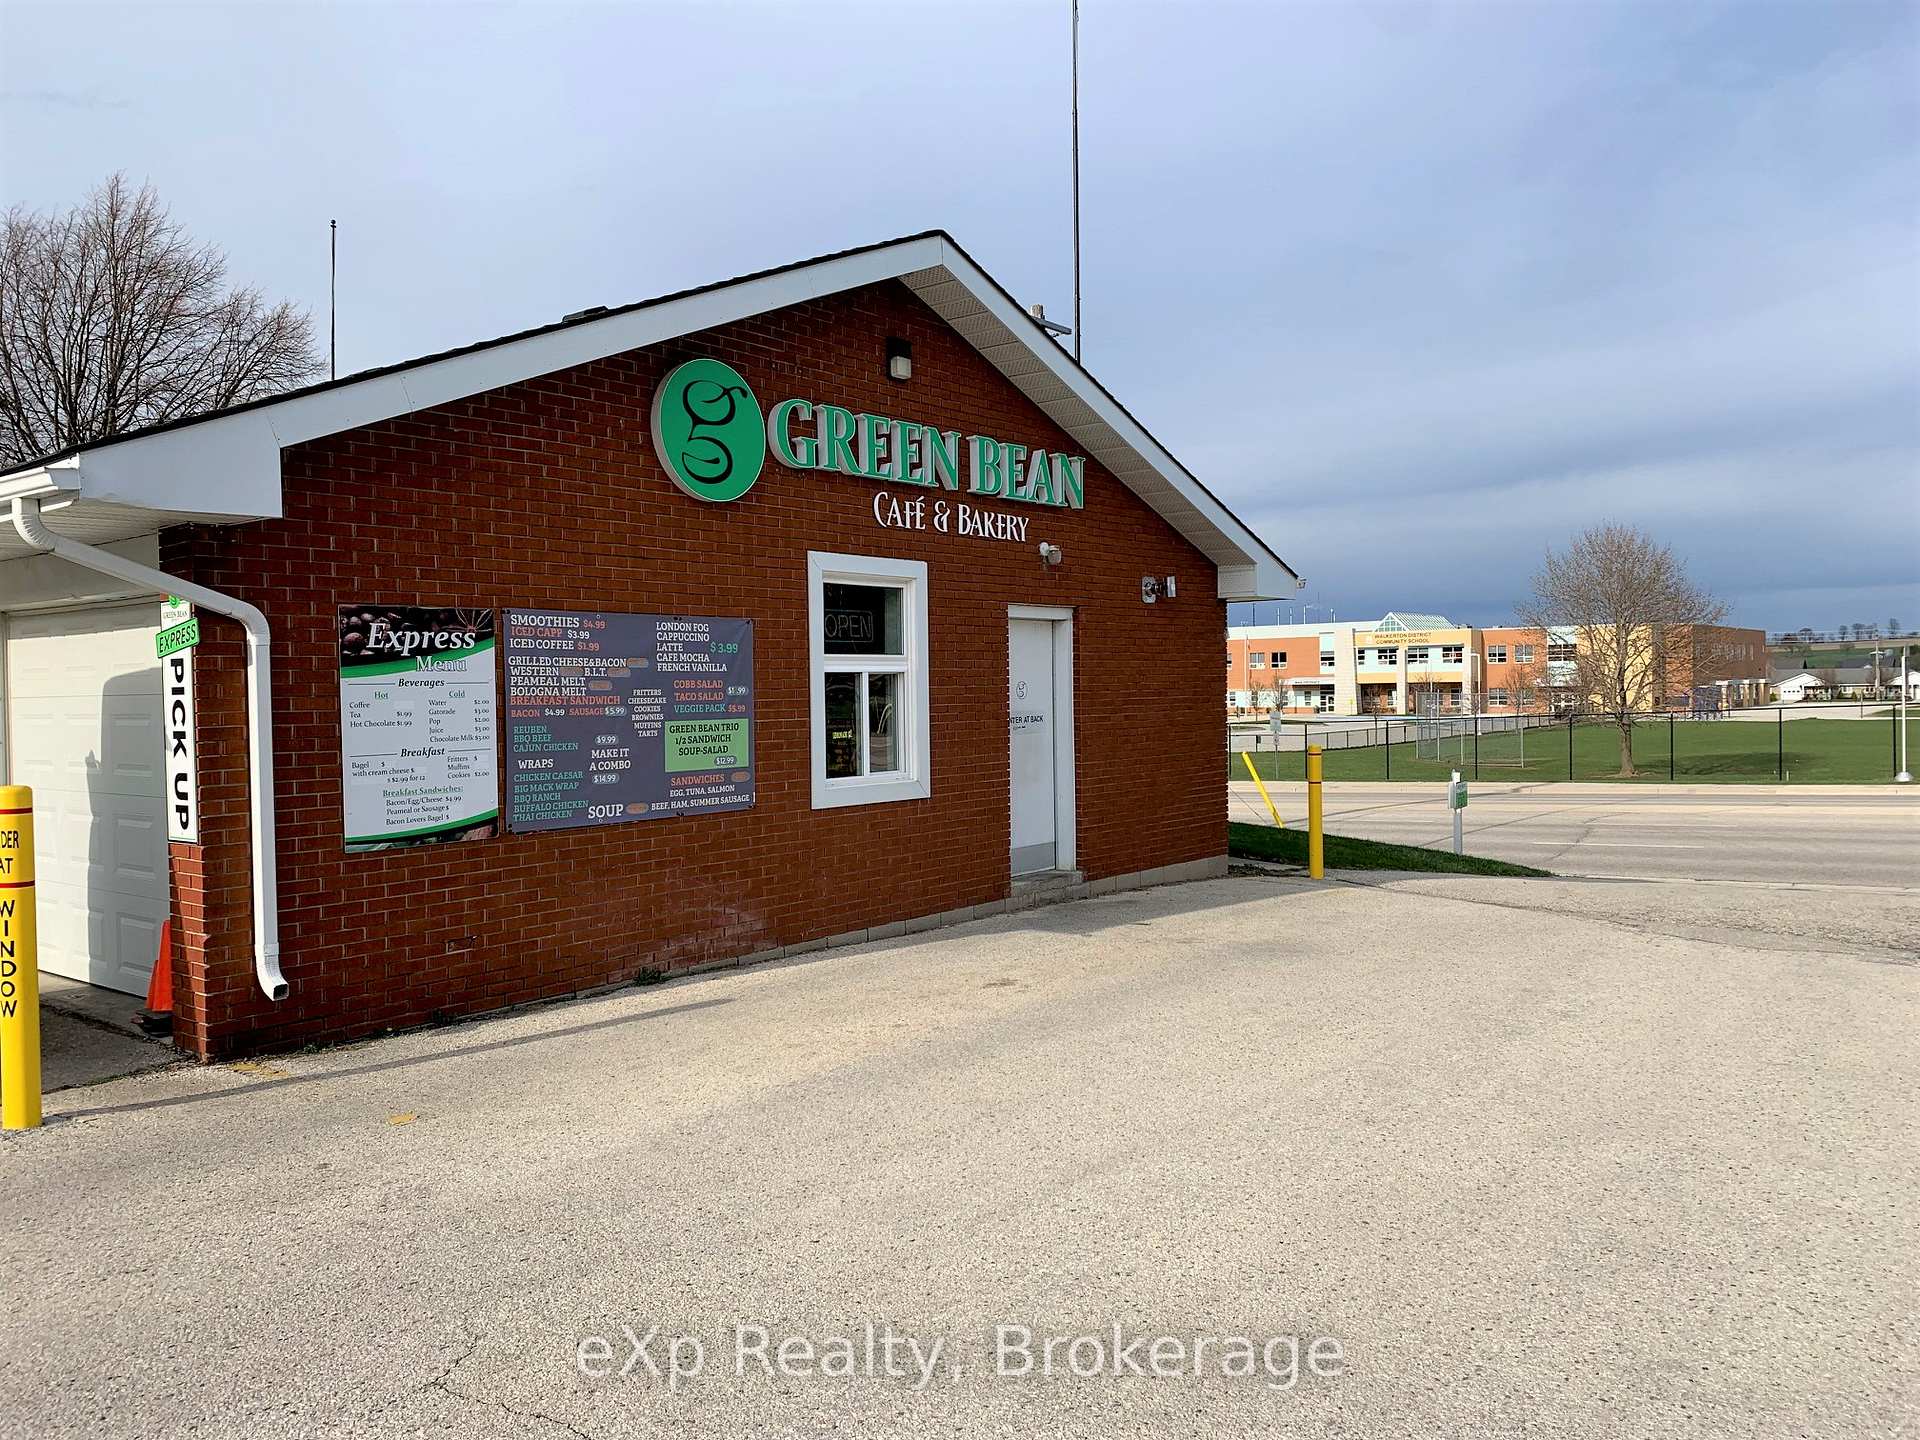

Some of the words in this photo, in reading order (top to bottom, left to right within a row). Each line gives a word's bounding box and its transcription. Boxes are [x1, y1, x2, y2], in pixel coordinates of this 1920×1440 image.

[768, 397, 961, 491] GREEN
[967, 434, 1086, 510] BEAN
[932, 499, 949, 533] &
[958, 504, 1029, 543] BAKERY
[510, 614, 580, 628] SMOOTHIES
[583, 620, 606, 629] $4.99
[825, 613, 872, 639] OPEN
[511, 626, 535, 636] ICED
[537, 627, 562, 637] CAPP
[567, 630, 590, 639] $3.99
[656, 622, 691, 632] LONDON
[693, 623, 709, 633] FOG
[160, 623, 196, 654] EXPRESS
[366, 622, 476, 656] Express
[656, 632, 710, 642] CAPPUCCINO
[510, 638, 535, 648] ICED
[536, 640, 574, 649] COFFEE
[577, 642, 600, 651] $1.99
[656, 643, 684, 651] LATTE
[508, 655, 551, 666] GRILLED
[656, 653, 678, 661] CAFE
[679, 653, 711, 661] MOCHA
[415, 655, 468, 672] Menu
[657, 663, 690, 671] FRENCH
[691, 664, 728, 672] VANILLA
[510, 666, 559, 676] WESTERN
[584, 667, 607, 676] B.L.T.
[398, 678, 446, 689] Beverages
[510, 677, 559, 686] PEAMEAL
[561, 677, 586, 686] MELT
[673, 680, 698, 688] COBB
[698, 680, 723, 688] SALAD
[374, 691, 389, 699] Hot
[448, 690, 465, 698] Cold
[510, 687, 560, 696] BOLOGNA
[561, 688, 587, 696] MELT
[674, 692, 698, 700] TACO
[698, 692, 724, 700] SALAD
[510, 696, 567, 705] BREAKFAST
[570, 696, 621, 705] SANDWICH
[628, 697, 667, 705] CHEESECAKE
[170, 658, 188, 758] PICK
[349, 702, 370, 710] Coffee
[633, 705, 661, 713] COOKIES
[674, 704, 704, 712] VEGGIE
[704, 703, 726, 712] PACK
[511, 709, 540, 717] BACON
[544, 707, 565, 716] $4.99
[568, 707, 605, 716] SAUSAGE
[631, 713, 664, 721] BROWNIES
[364, 719, 395, 727] Chocolate
[1023, 715, 1030, 723] AT
[1030, 715, 1044, 723] BACK
[513, 726, 547, 734] REUBEN
[633, 721, 662, 729] MUFFINS
[669, 724, 697, 733] GREEN
[698, 723, 719, 732] BEAN
[513, 734, 531, 743] BBQ
[532, 734, 552, 742] BEEF
[596, 735, 616, 743] $9.99
[637, 730, 658, 738] TARTS
[674, 736, 687, 745] 1/2
[687, 733, 732, 744] SANDWICH
[400, 747, 446, 757] Breakfast
[513, 743, 541, 752] CAJUN
[542, 742, 579, 751] CHICKEN
[678, 745, 728, 756] SOUP-SALAD
[591, 748, 619, 759] MAKE
[619, 747, 630, 757] IT
[351, 761, 369, 769] Bagel
[518, 758, 554, 769] WRAPS
[589, 762, 597, 770] A
[597, 760, 632, 771] COMBO
[716, 757, 734, 765] $12.99
[389, 767, 410, 775] cheese
[447, 772, 471, 780] Cookies
[514, 772, 551, 781] CHICKEN
[552, 771, 584, 780] CAESAR
[593, 774, 616, 782] $14.99
[671, 774, 725, 785] SANDWICHES
[382, 788, 418, 797] Breakfast
[514, 784, 530, 793] BIG
[529, 783, 554, 792] MACK
[555, 782, 579, 791] WRAP
[707, 785, 735, 794] SALMON
[174, 772, 190, 831] UP
[514, 794, 531, 803] BBQ
[532, 793, 561, 802] RANCH
[690, 797, 720, 807] SUMMER
[720, 794, 750, 804] SAUSAGE
[386, 808, 412, 816] Peameal
[421, 805, 446, 813] Sausage
[514, 803, 551, 813] BUFFALO
[552, 800, 589, 810] CHICKEN
[588, 803, 624, 819] SOUP
[386, 818, 405, 826] Bacon
[406, 816, 427, 824] Lovers
[427, 814, 444, 822] Bagel
[512, 813, 534, 822] THAI
[536, 810, 573, 819] CHICKEN
[0, 830, 20, 849] DER
[0, 899, 17, 1017] WINDOW
